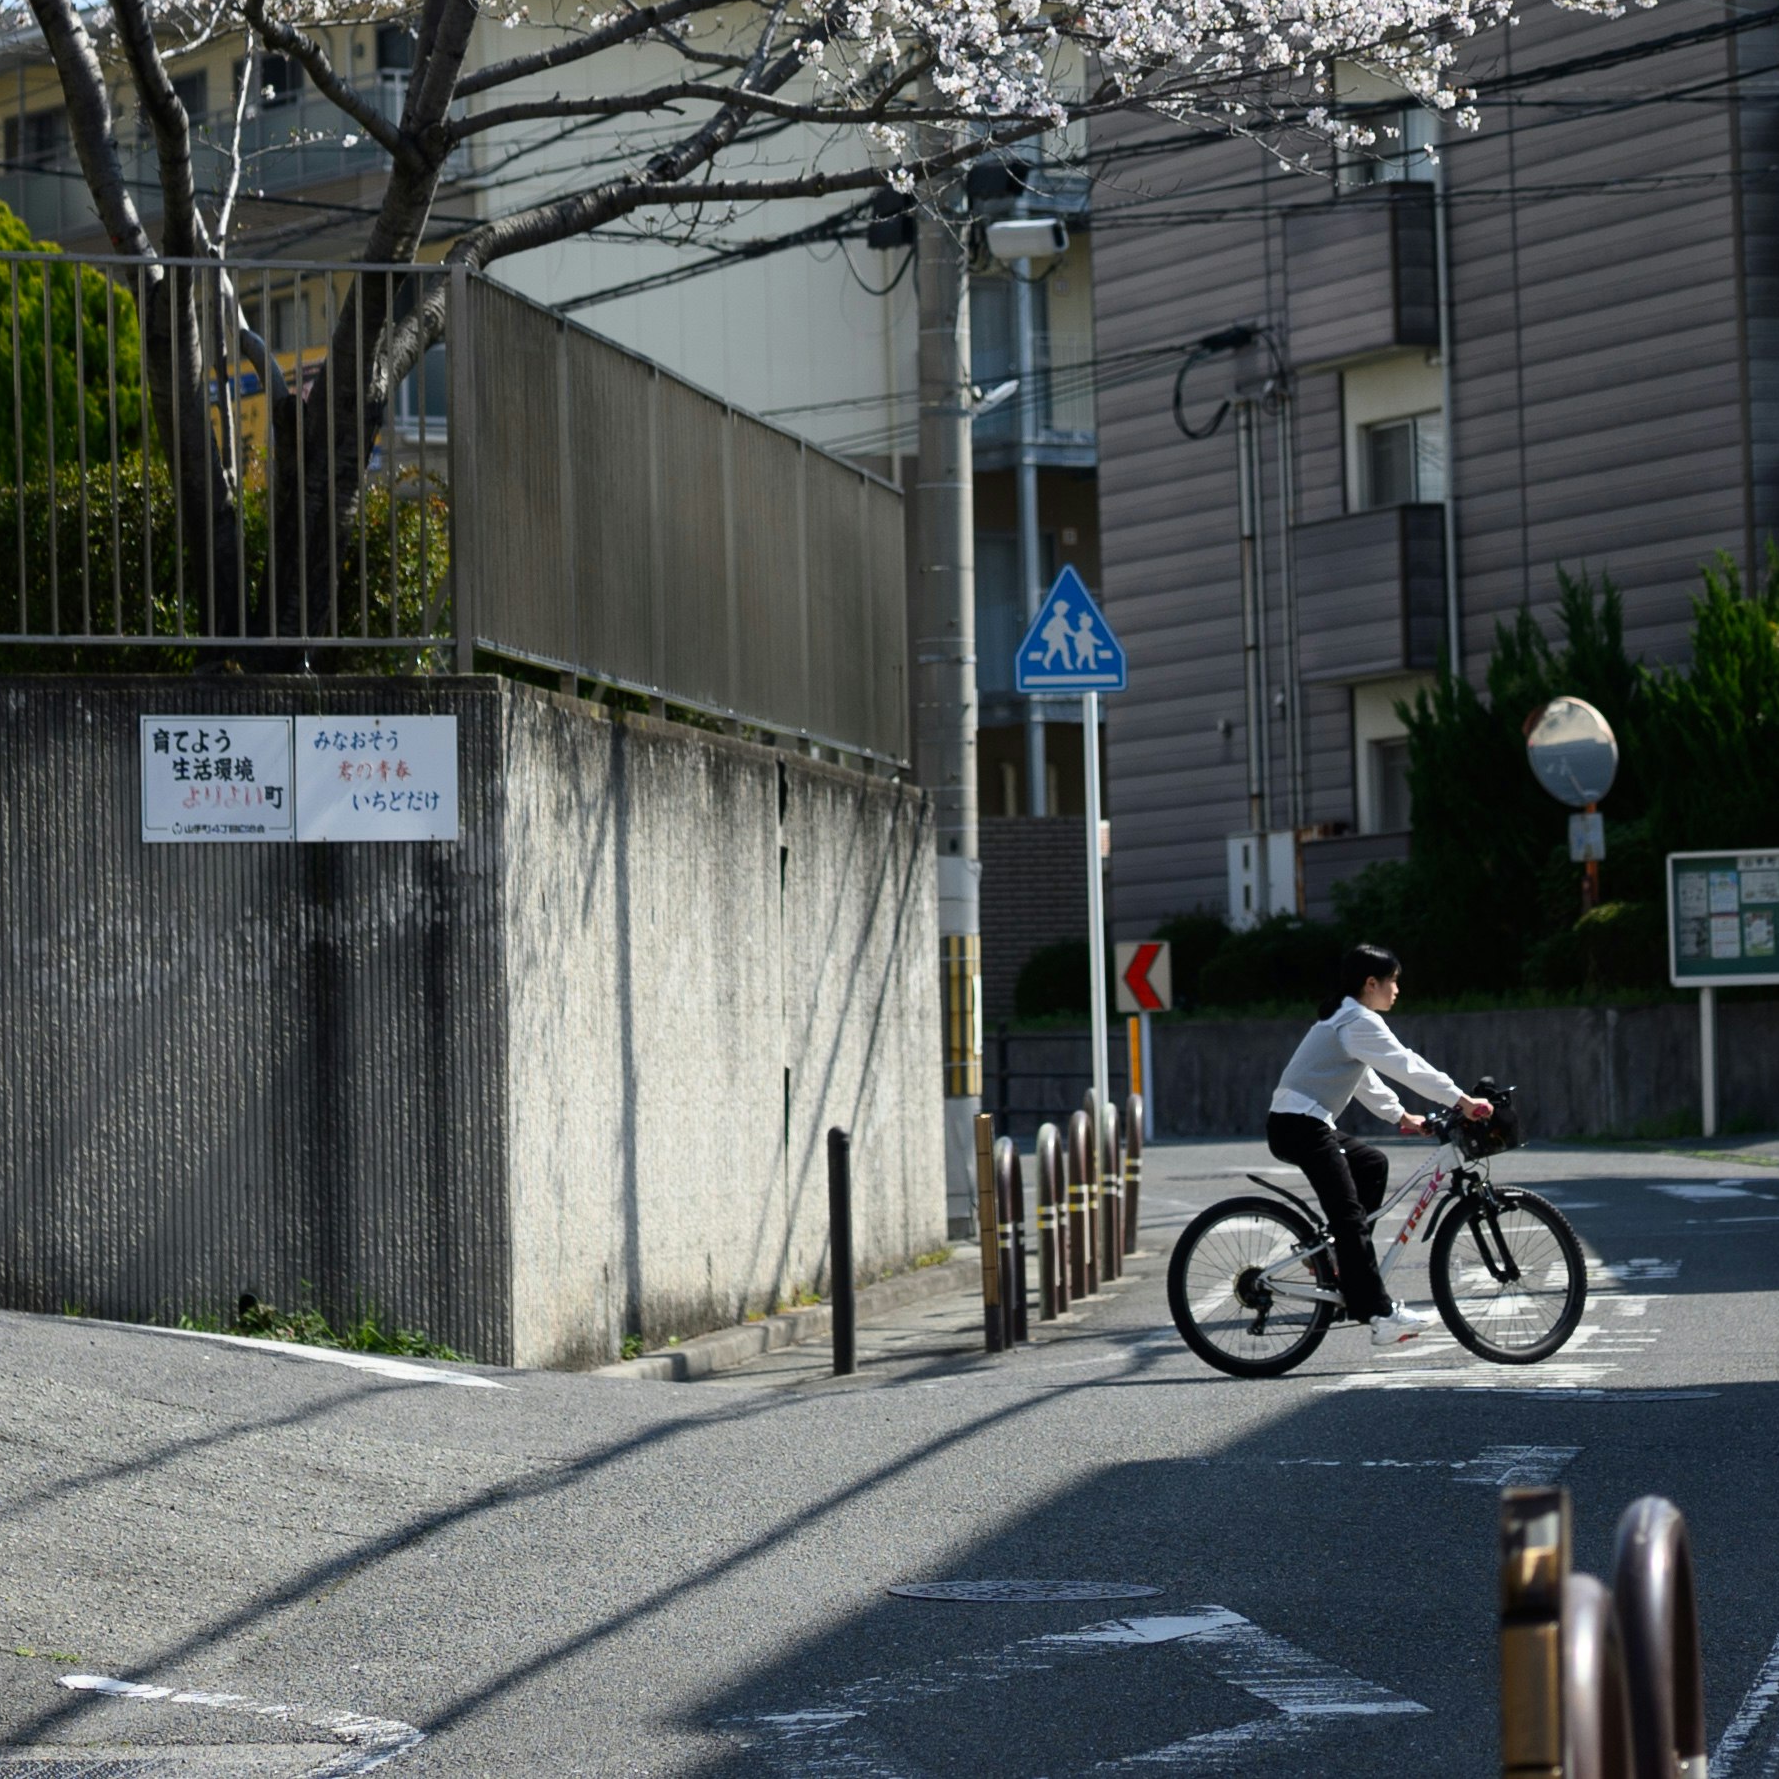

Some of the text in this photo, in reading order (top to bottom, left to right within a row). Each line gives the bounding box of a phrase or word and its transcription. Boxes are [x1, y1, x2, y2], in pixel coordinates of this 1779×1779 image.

[152, 728, 232, 754] 育てよう
[313, 729, 400, 751] みなおそう
[172, 757, 256, 783] 生活環境
[337, 760, 412, 783] 君の青春
[182, 785, 284, 810] よりよい町
[352, 791, 440, 813] いちどだけ
[1397, 1163, 1446, 1246] TREK
